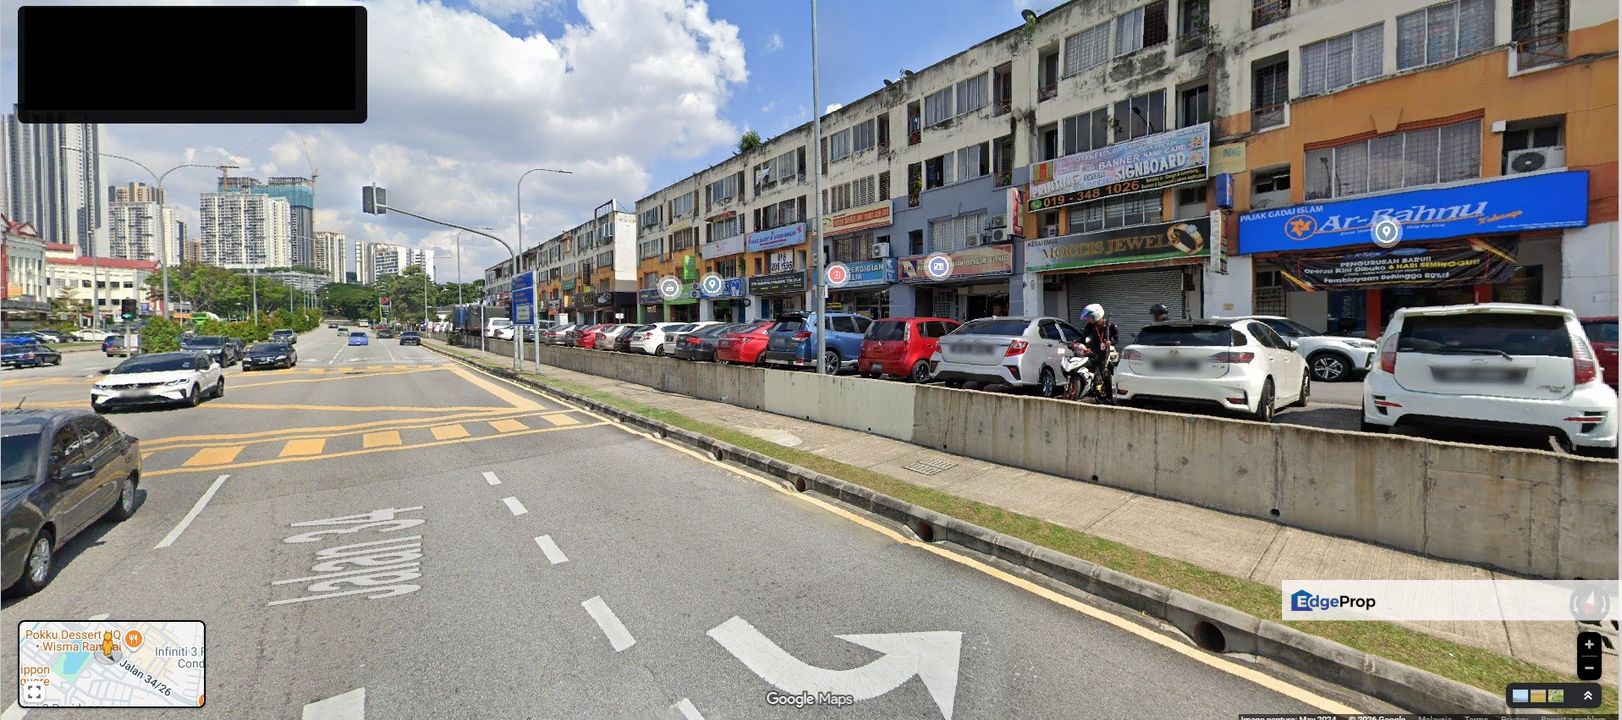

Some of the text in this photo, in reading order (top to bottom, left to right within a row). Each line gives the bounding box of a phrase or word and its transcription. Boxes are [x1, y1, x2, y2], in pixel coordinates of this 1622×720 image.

[1098, 154, 1140, 170] BANNER
[1031, 175, 1080, 198] PRINTING
[1115, 153, 1186, 181] SIGNBOARD
[1044, 195, 1065, 207] 019
[1078, 189, 1100, 201] 348
[1106, 180, 1140, 195] 1026
[1240, 205, 1324, 223] PAJAK GADAI ISLAM
[1340, 258, 1400, 268] PENGURUSAN
[264, 505, 426, 607] Jalan 34
